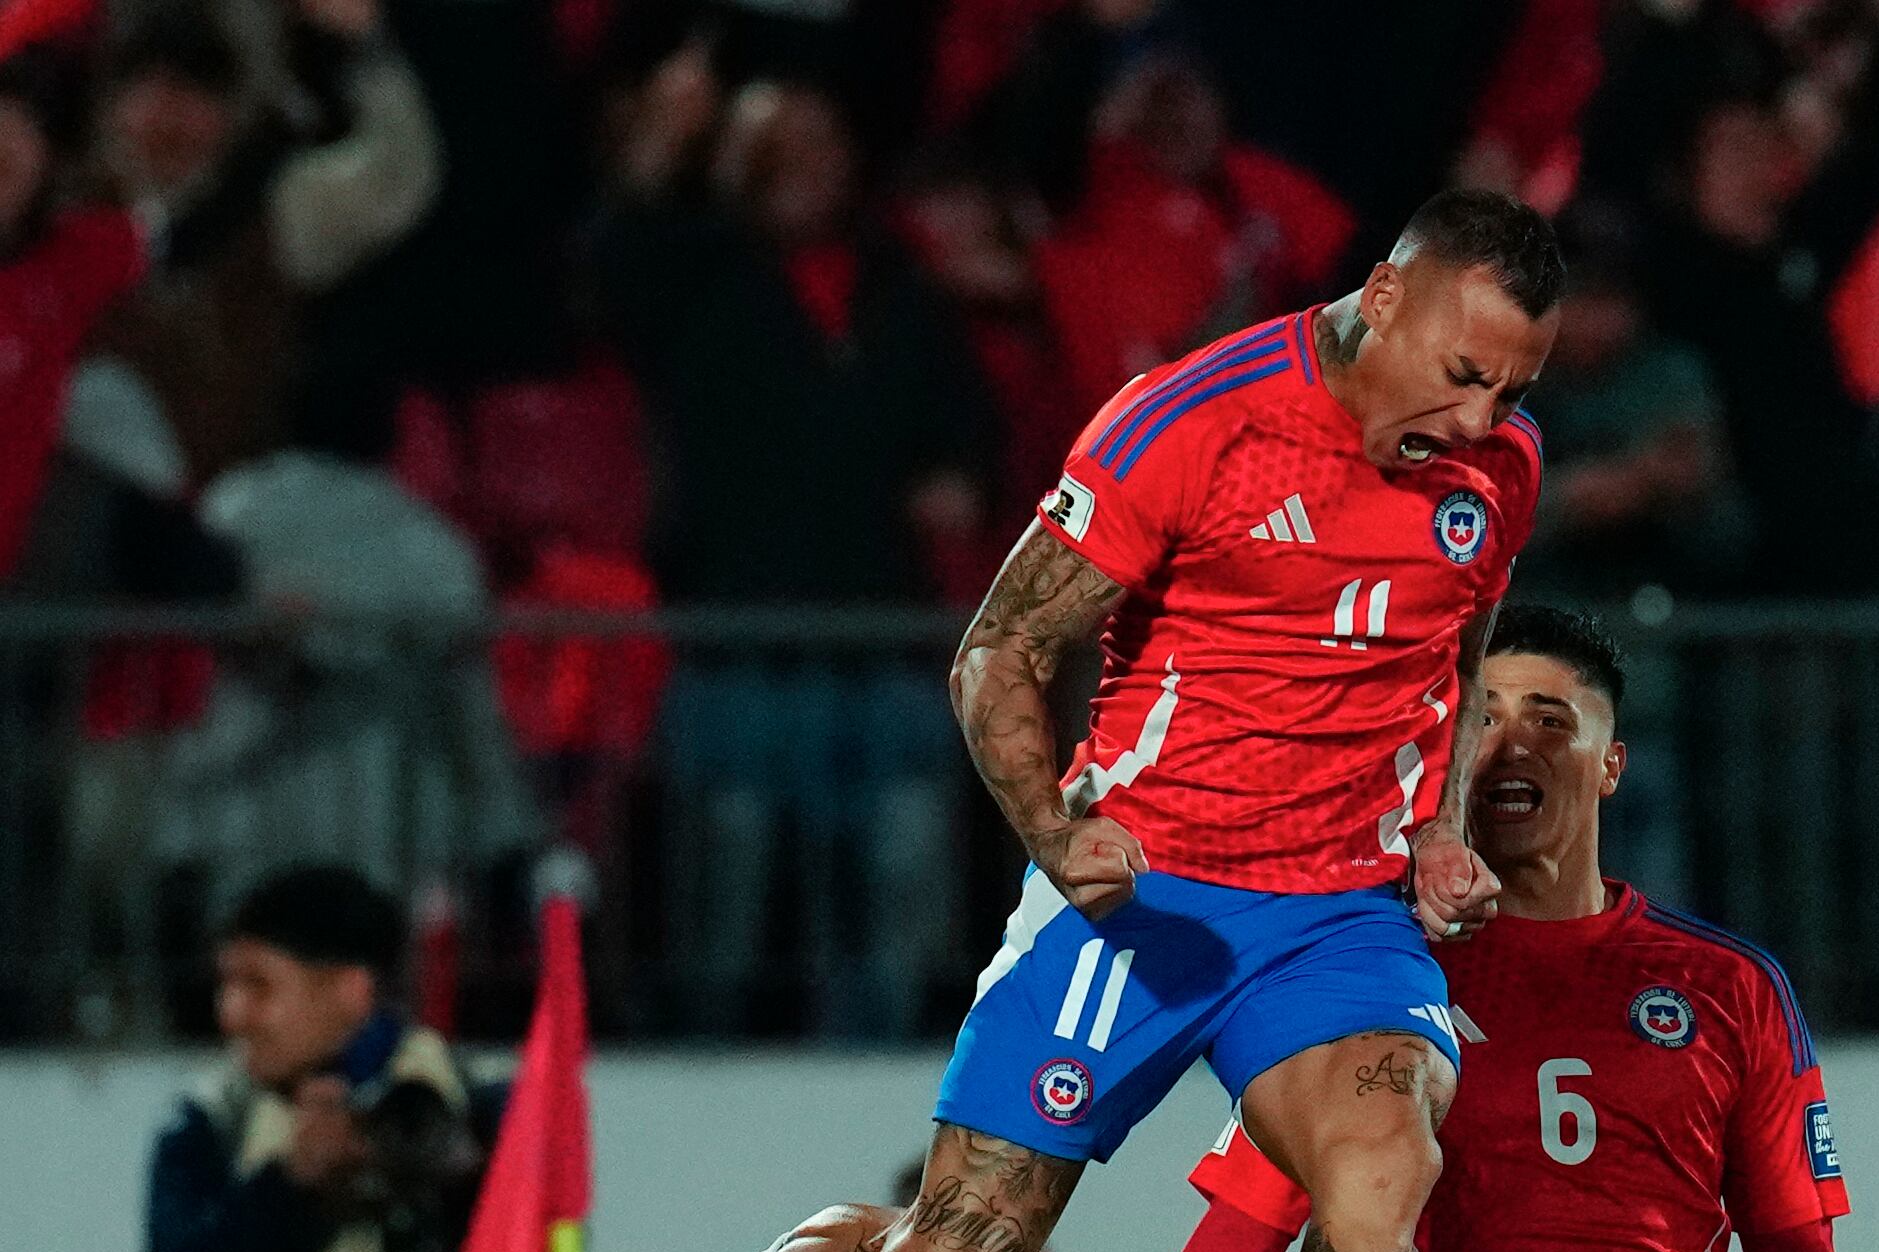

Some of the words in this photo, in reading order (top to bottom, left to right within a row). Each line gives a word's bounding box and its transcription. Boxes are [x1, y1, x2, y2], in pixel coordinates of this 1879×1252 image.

[1320, 578, 1391, 651] 11
[1053, 938, 1136, 1053] 11
[1537, 1057, 1597, 1165] 6
